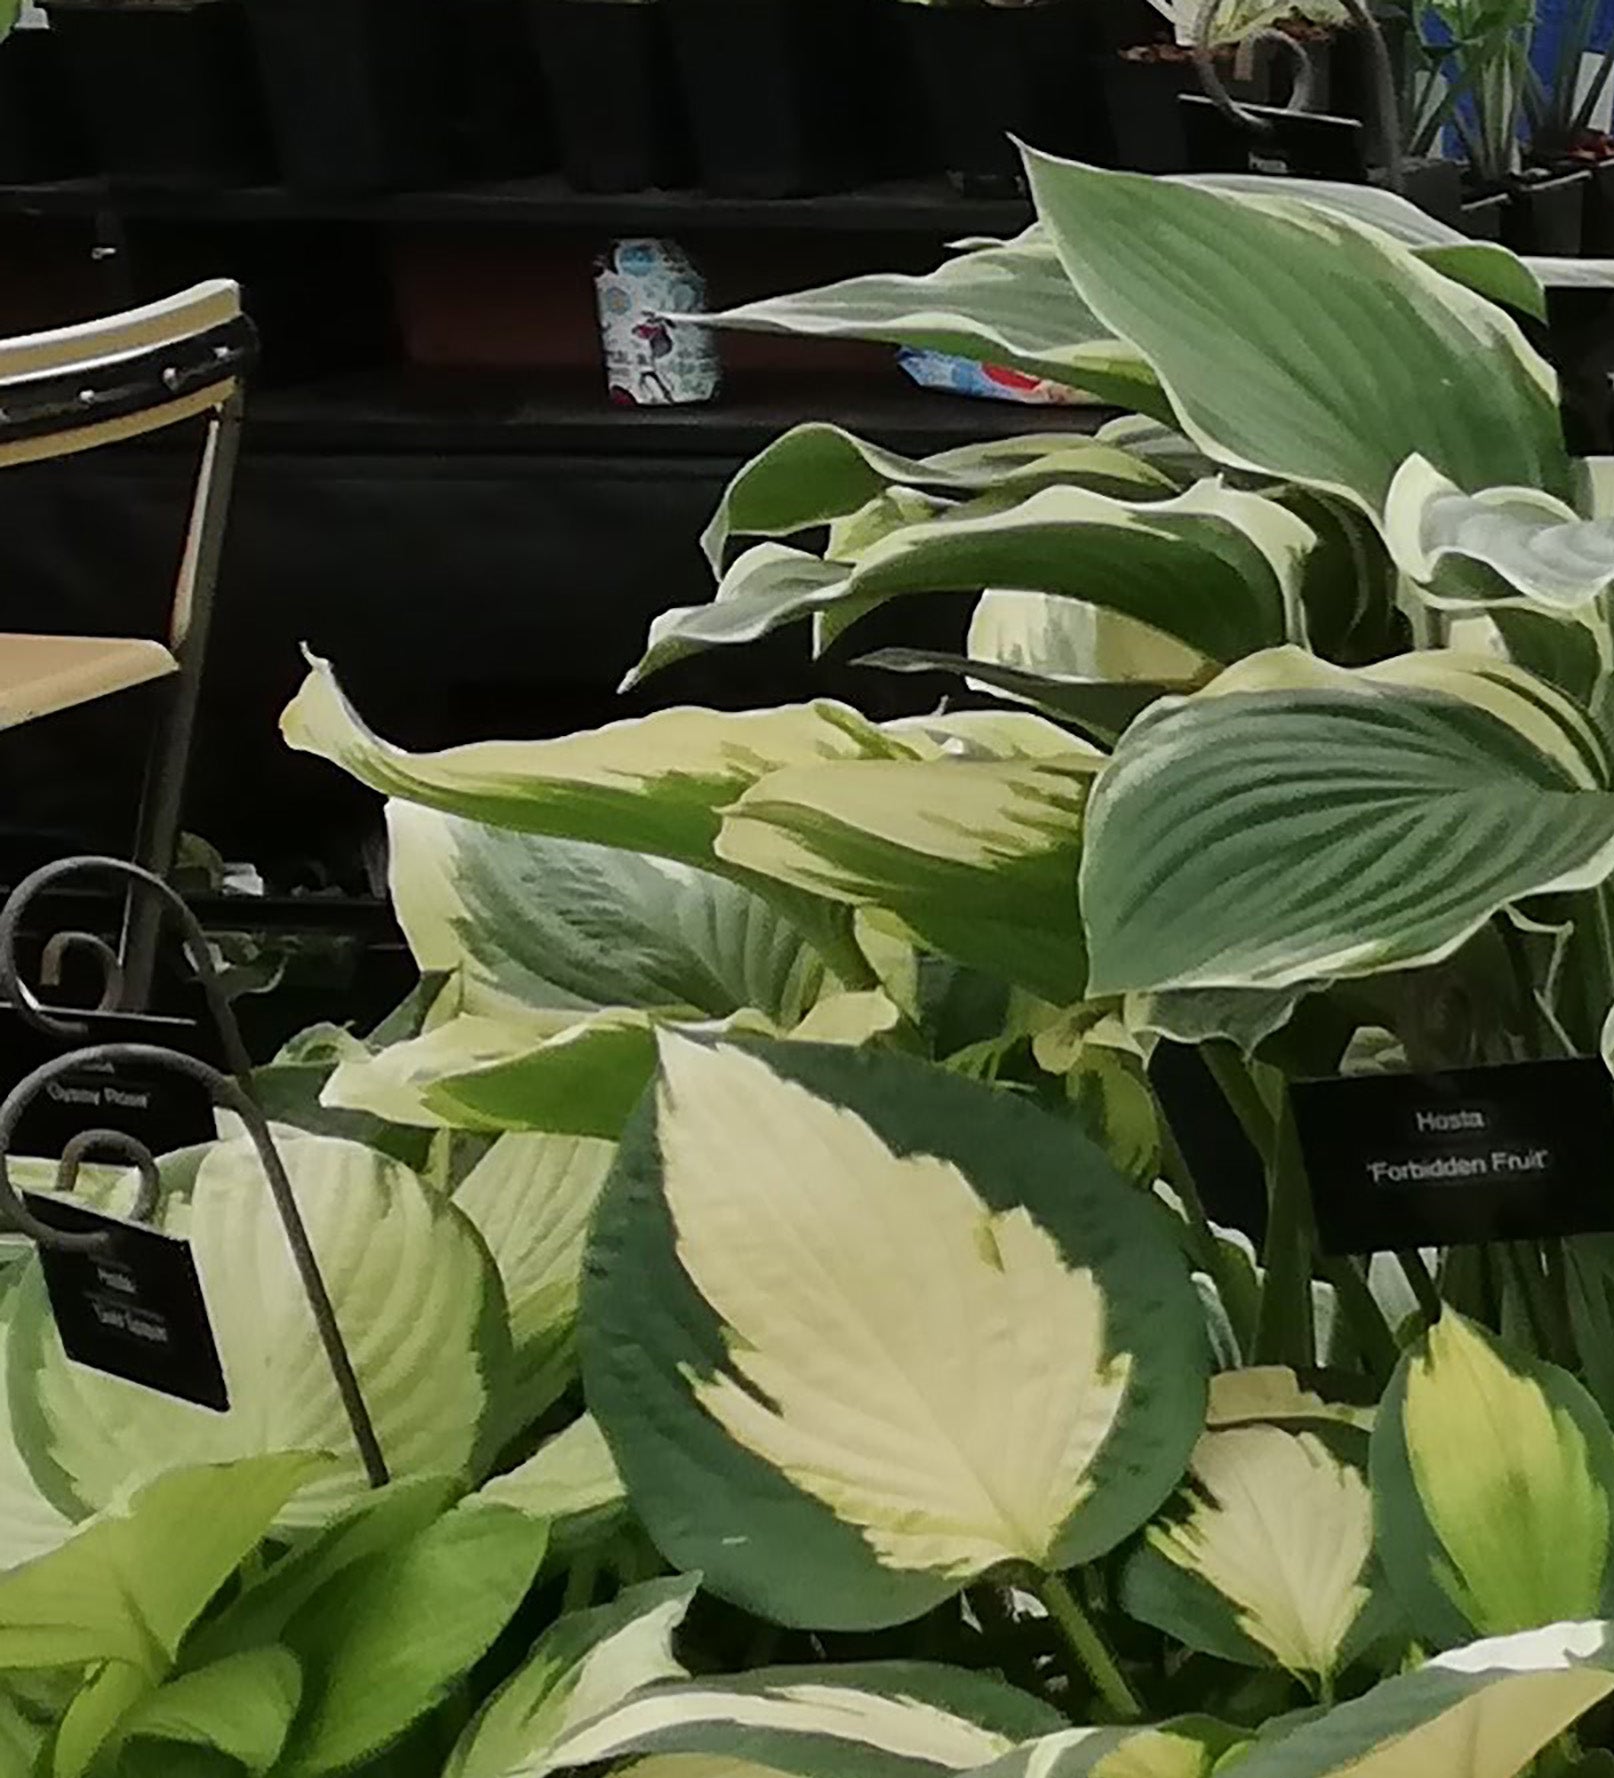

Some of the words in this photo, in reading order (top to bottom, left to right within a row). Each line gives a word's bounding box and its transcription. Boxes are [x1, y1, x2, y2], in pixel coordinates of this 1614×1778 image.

[1416, 1110, 1486, 1132] Hosta
[1367, 1156, 1486, 1183] 'Forbidden
[1492, 1149, 1549, 1173] Fruit'
